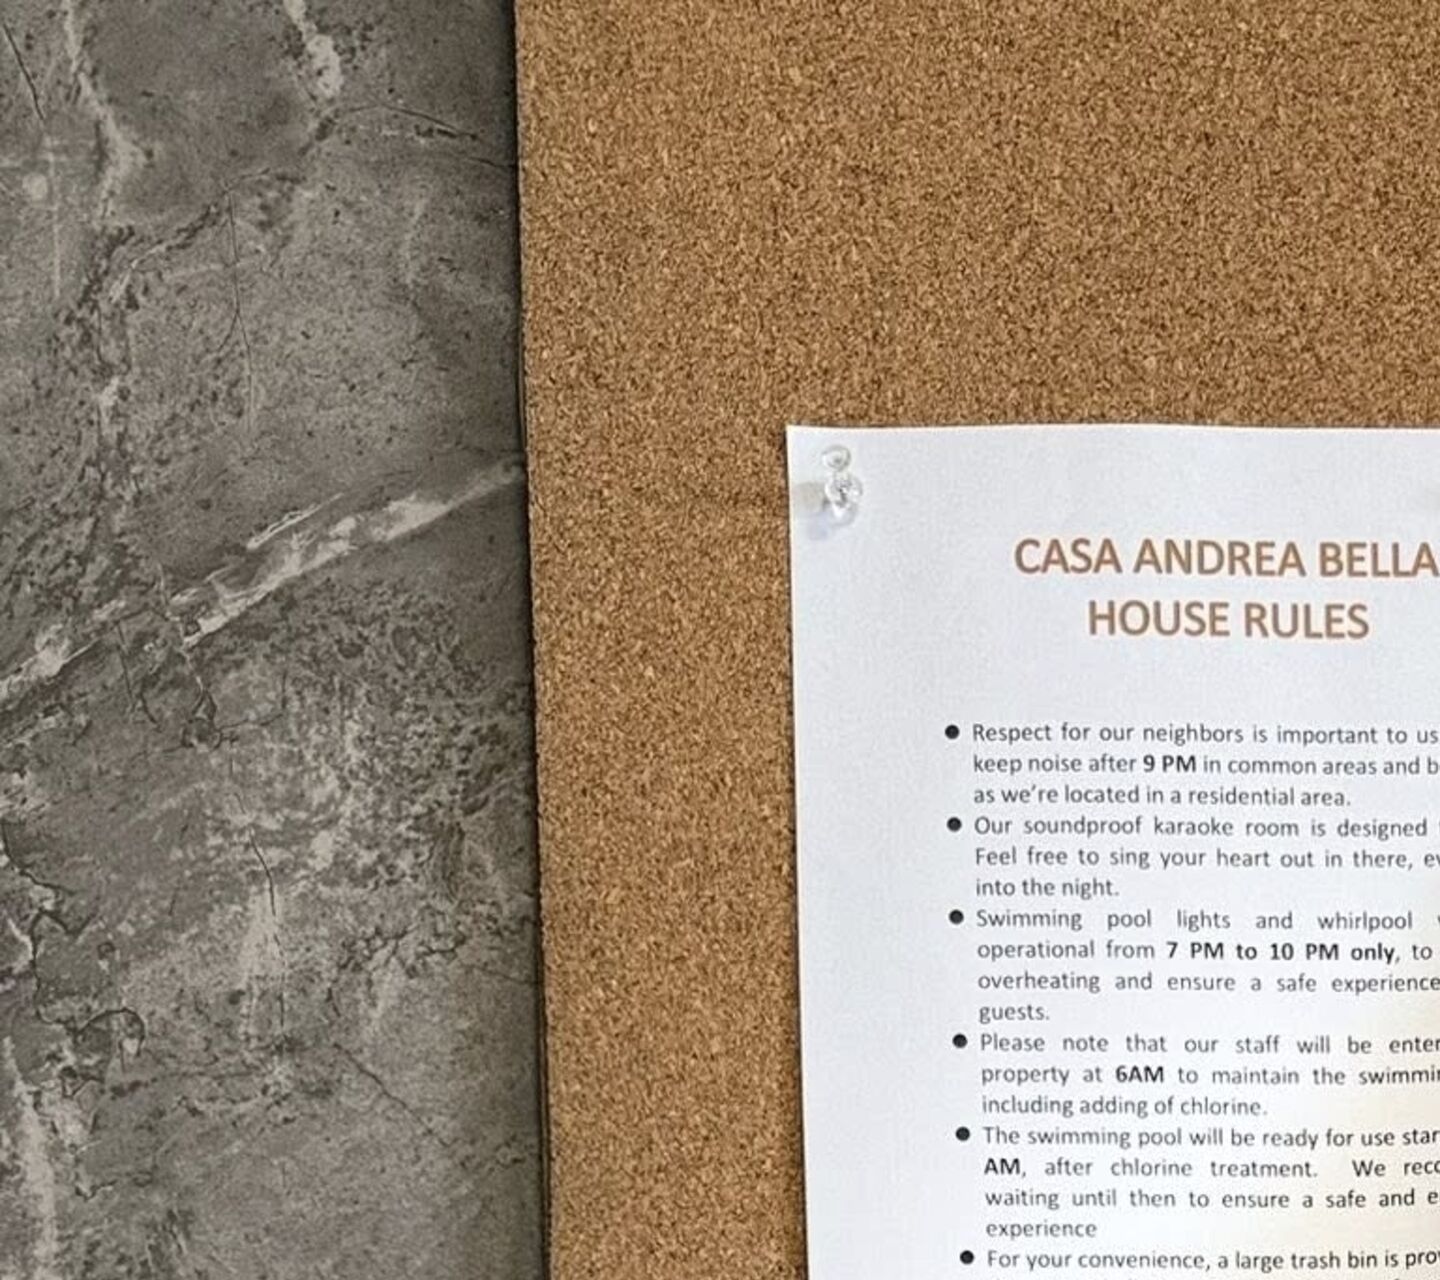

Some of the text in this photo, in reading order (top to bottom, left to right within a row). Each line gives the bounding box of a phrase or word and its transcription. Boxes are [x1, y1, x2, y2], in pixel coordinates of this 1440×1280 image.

[1014, 538, 1440, 578] CASA ANDREA BELLA
[1089, 600, 1369, 640] HOUSE RULES
[973, 723, 1052, 745] Respect
[1061, 722, 1091, 741] for
[1099, 727, 1135, 741] our
[1143, 723, 1244, 747] neighbors
[1253, 724, 1268, 743] is
[1277, 725, 1378, 747] important
[1386, 727, 1408, 744] to
[973, 754, 1022, 776] keep
[1028, 754, 1082, 772] noise
[1089, 753, 1137, 773] after
[1143, 754, 1156, 773] 9
[1162, 754, 1197, 773] PM
[1203, 755, 1221, 774] in
[1228, 760, 1316, 775] common
[1322, 761, 1377, 775] areas
[1383, 756, 1420, 775] and
[974, 789, 995, 804] as
[1065, 784, 1140, 804] located
[1147, 785, 1164, 804] in
[1170, 790, 1181, 804] a
[1188, 786, 1294, 806] residential
[1301, 792, 1351, 806] area.
[974, 815, 1013, 835] Our
[1024, 815, 1143, 839] soundproof
[1154, 815, 1234, 836] karaoke
[1246, 822, 1299, 837] room
[1311, 819, 1326, 837] is
[1337, 817, 1427, 842] designed
[975, 845, 1017, 866] Feel
[1027, 845, 1068, 865] free
[1078, 848, 1099, 866] to
[1110, 847, 1150, 870] sing
[1160, 852, 1206, 870] your
[1217, 847, 1271, 868] heart
[1280, 851, 1314, 868] out
[1325, 849, 1343, 867] in
[1353, 849, 1413, 871] there,
[976, 877, 1119, 901] into the night.
[976, 909, 1083, 932] Swimming
[1107, 908, 1152, 931] pool
[1177, 909, 1231, 933] lights
[1256, 910, 1293, 930] and
[1317, 910, 1412, 934] whirlpool
[977, 939, 1095, 962] operational
[1106, 939, 1155, 959] from
[1166, 941, 1178, 959] 7
[1190, 941, 1224, 960] PM
[1235, 943, 1258, 960] to
[1270, 942, 1294, 961] 10
[1305, 943, 1339, 961] PM
[1350, 942, 1400, 965] only,
[1412, 944, 1433, 960] to
[979, 1004, 1050, 1025] guests.
[981, 1032, 1045, 1052] Please
[1063, 1035, 1109, 1052] note
[1126, 1033, 1168, 1053] that
[1184, 1038, 1219, 1053] our
[1236, 1034, 1280, 1054] staff
[1296, 1035, 1330, 1054] will
[1347, 1035, 1372, 1055] be
[982, 1066, 1070, 1087] property
[1083, 1066, 1103, 1083] at
[1115, 1065, 1165, 1084] 6AM
[1178, 1067, 1199, 1084] to
[1212, 1066, 1300, 1085] maintain
[1312, 1066, 1346, 1086] the
[984, 1157, 1026, 1179] AM,
[1044, 1156, 1093, 1176] after
[1110, 1157, 1193, 1177] chlorine
[1210, 1160, 1318, 1178] treatment.
[1352, 1159, 1386, 1178] We
